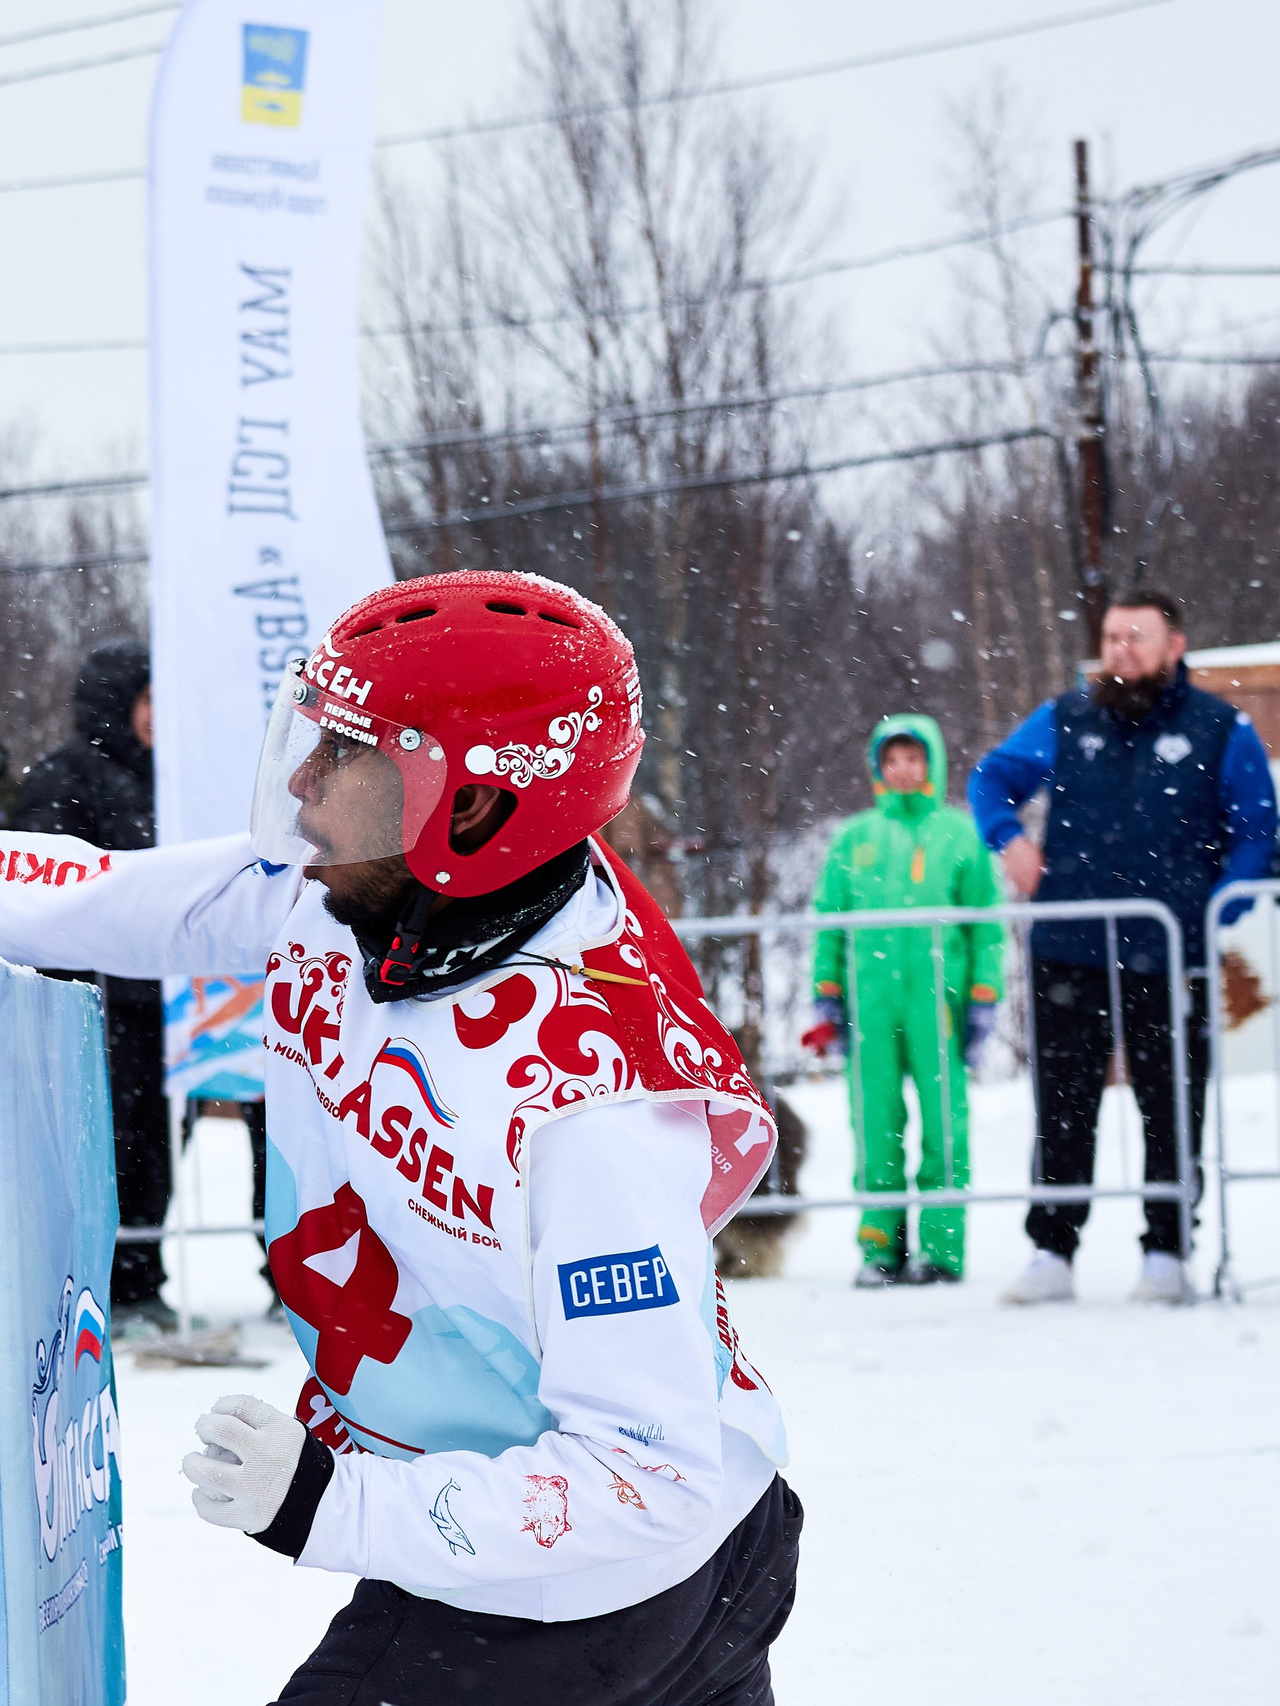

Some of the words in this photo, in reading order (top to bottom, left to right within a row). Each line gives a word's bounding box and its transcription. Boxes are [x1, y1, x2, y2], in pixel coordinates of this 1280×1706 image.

[305, 653, 373, 706] ССЕН
[323, 702, 372, 729] ПЕРВЫЕ
[328, 721, 378, 747] РОССИИ
[316, 1086, 344, 1121] REGIO
[407, 1198, 467, 1241] СНЕЖНЫЙ
[471, 1232, 502, 1251] БОЙ
[268, 1181, 413, 1396] 4
[569, 1257, 667, 1308] СЕВЕР
